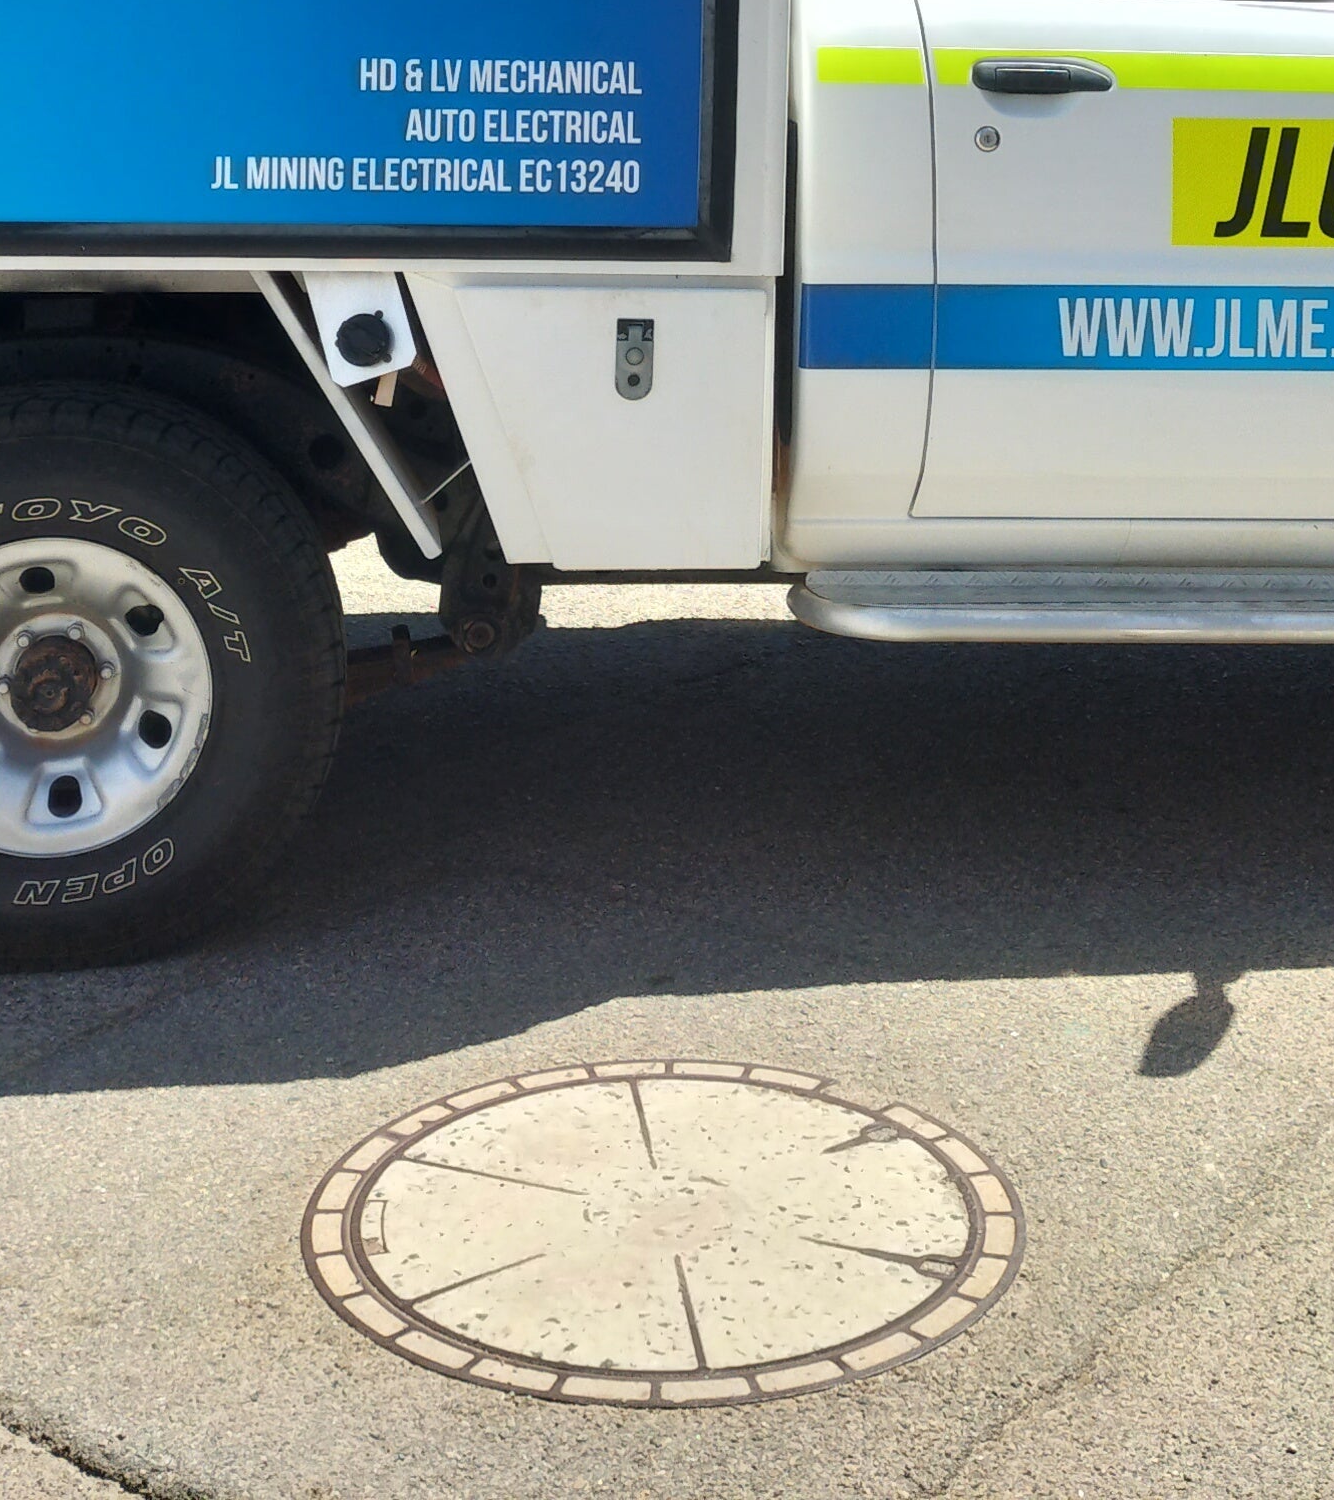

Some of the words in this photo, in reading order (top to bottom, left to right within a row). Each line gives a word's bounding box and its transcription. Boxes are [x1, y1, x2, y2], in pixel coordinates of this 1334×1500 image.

[360, 57, 397, 93] HD
[404, 58, 424, 93] &
[431, 58, 462, 94] LV
[470, 59, 643, 96] MECHANICAL
[405, 108, 476, 143] AUTO
[484, 109, 641, 145] ELECTRICAL
[210, 156, 239, 191] JL
[247, 157, 344, 192] MINING
[352, 157, 512, 193] ELECTRICAL
[519, 158, 641, 194] EC13240
[178, 565, 253, 663] A/T
[12, 837, 176, 907] OPEN
